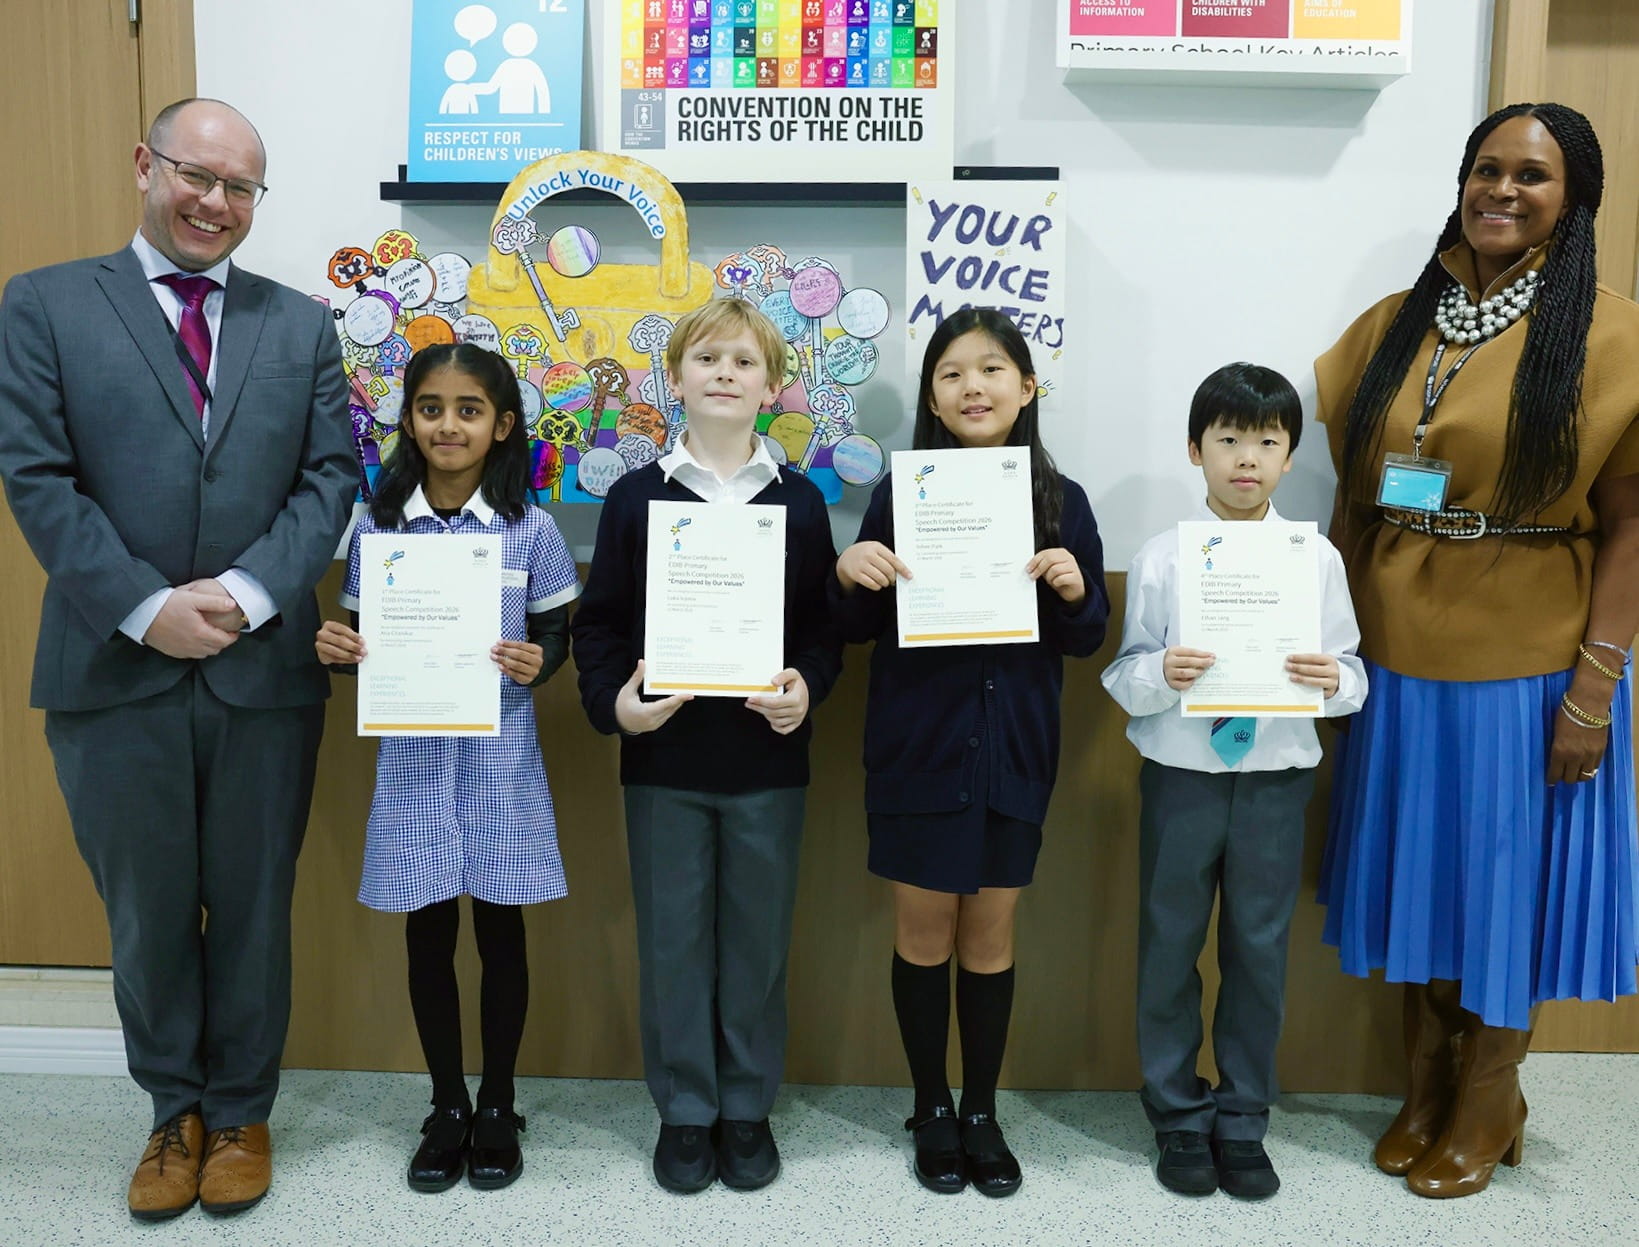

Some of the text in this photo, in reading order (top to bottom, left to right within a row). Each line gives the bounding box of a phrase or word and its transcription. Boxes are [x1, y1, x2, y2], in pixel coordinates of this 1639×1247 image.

[1080, 7, 1145, 16] INFORMATION
[1192, 7, 1252, 16] DISABILITIES
[1304, 8, 1356, 17] EDUCATION
[638, 92, 662, 101] 43-54
[678, 97, 923, 118] CONVENTION ON THE
[678, 120, 923, 142] RIGHTS OF THE CHILD
[424, 132, 521, 144] RESPECT FOR
[424, 148, 508, 160] CHILDREN'S
[508, 170, 665, 236] Unlock Your Voice
[928, 200, 1052, 250] YOUR
[921, 251, 1049, 302] VOICE
[908, 294, 1064, 348] MTERS
[691, 571, 729, 579] Competition
